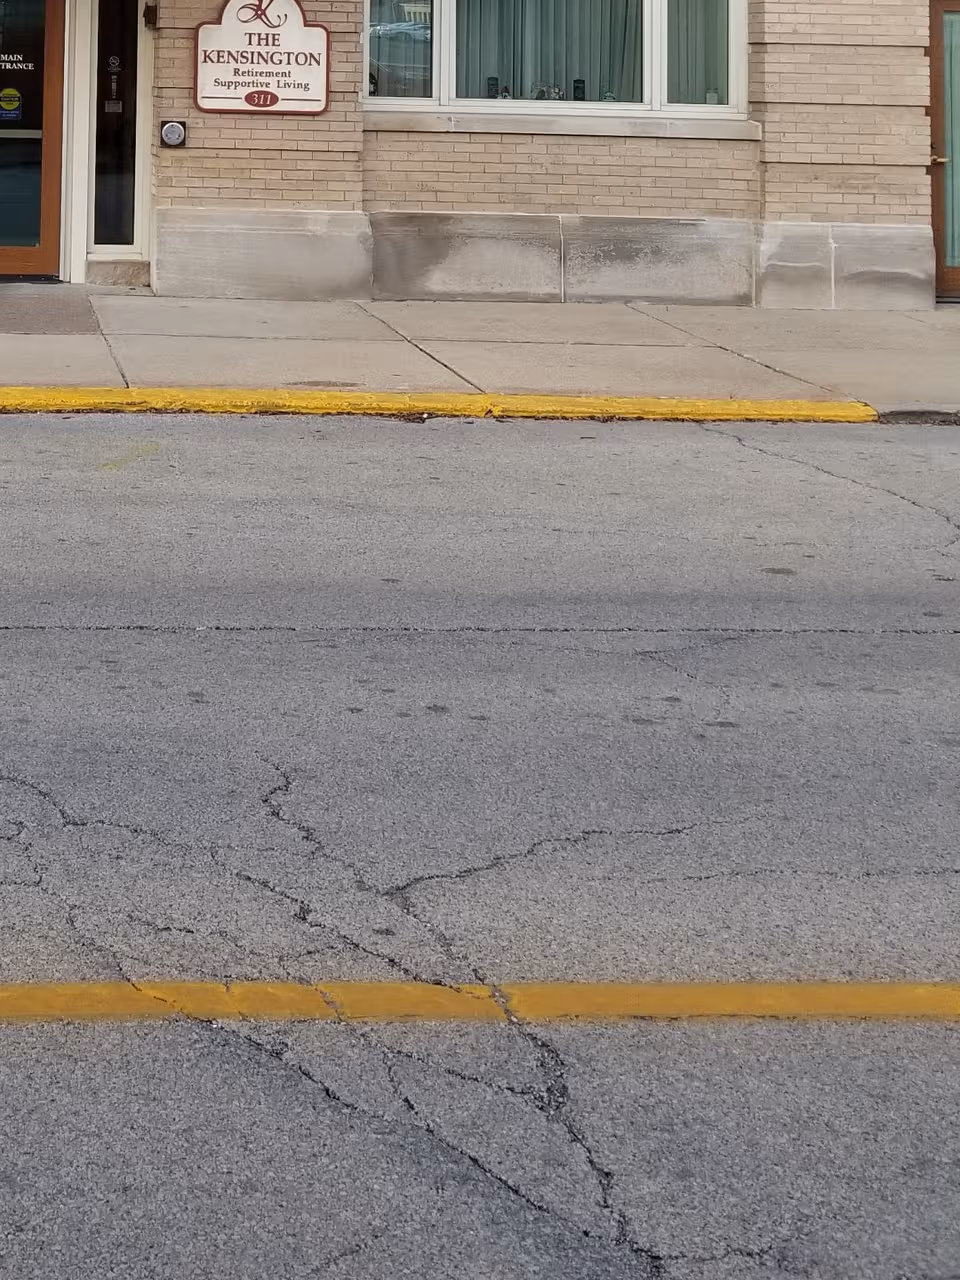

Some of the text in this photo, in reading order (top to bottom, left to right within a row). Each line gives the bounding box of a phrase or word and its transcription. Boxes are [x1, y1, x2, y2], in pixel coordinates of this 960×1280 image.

[244, 32, 281, 47] THE
[202, 49, 322, 67] KENSINGTON
[233, 67, 292, 78] Retirement
[213, 77, 310, 91] Supportive Living
[250, 94, 272, 105] 311
